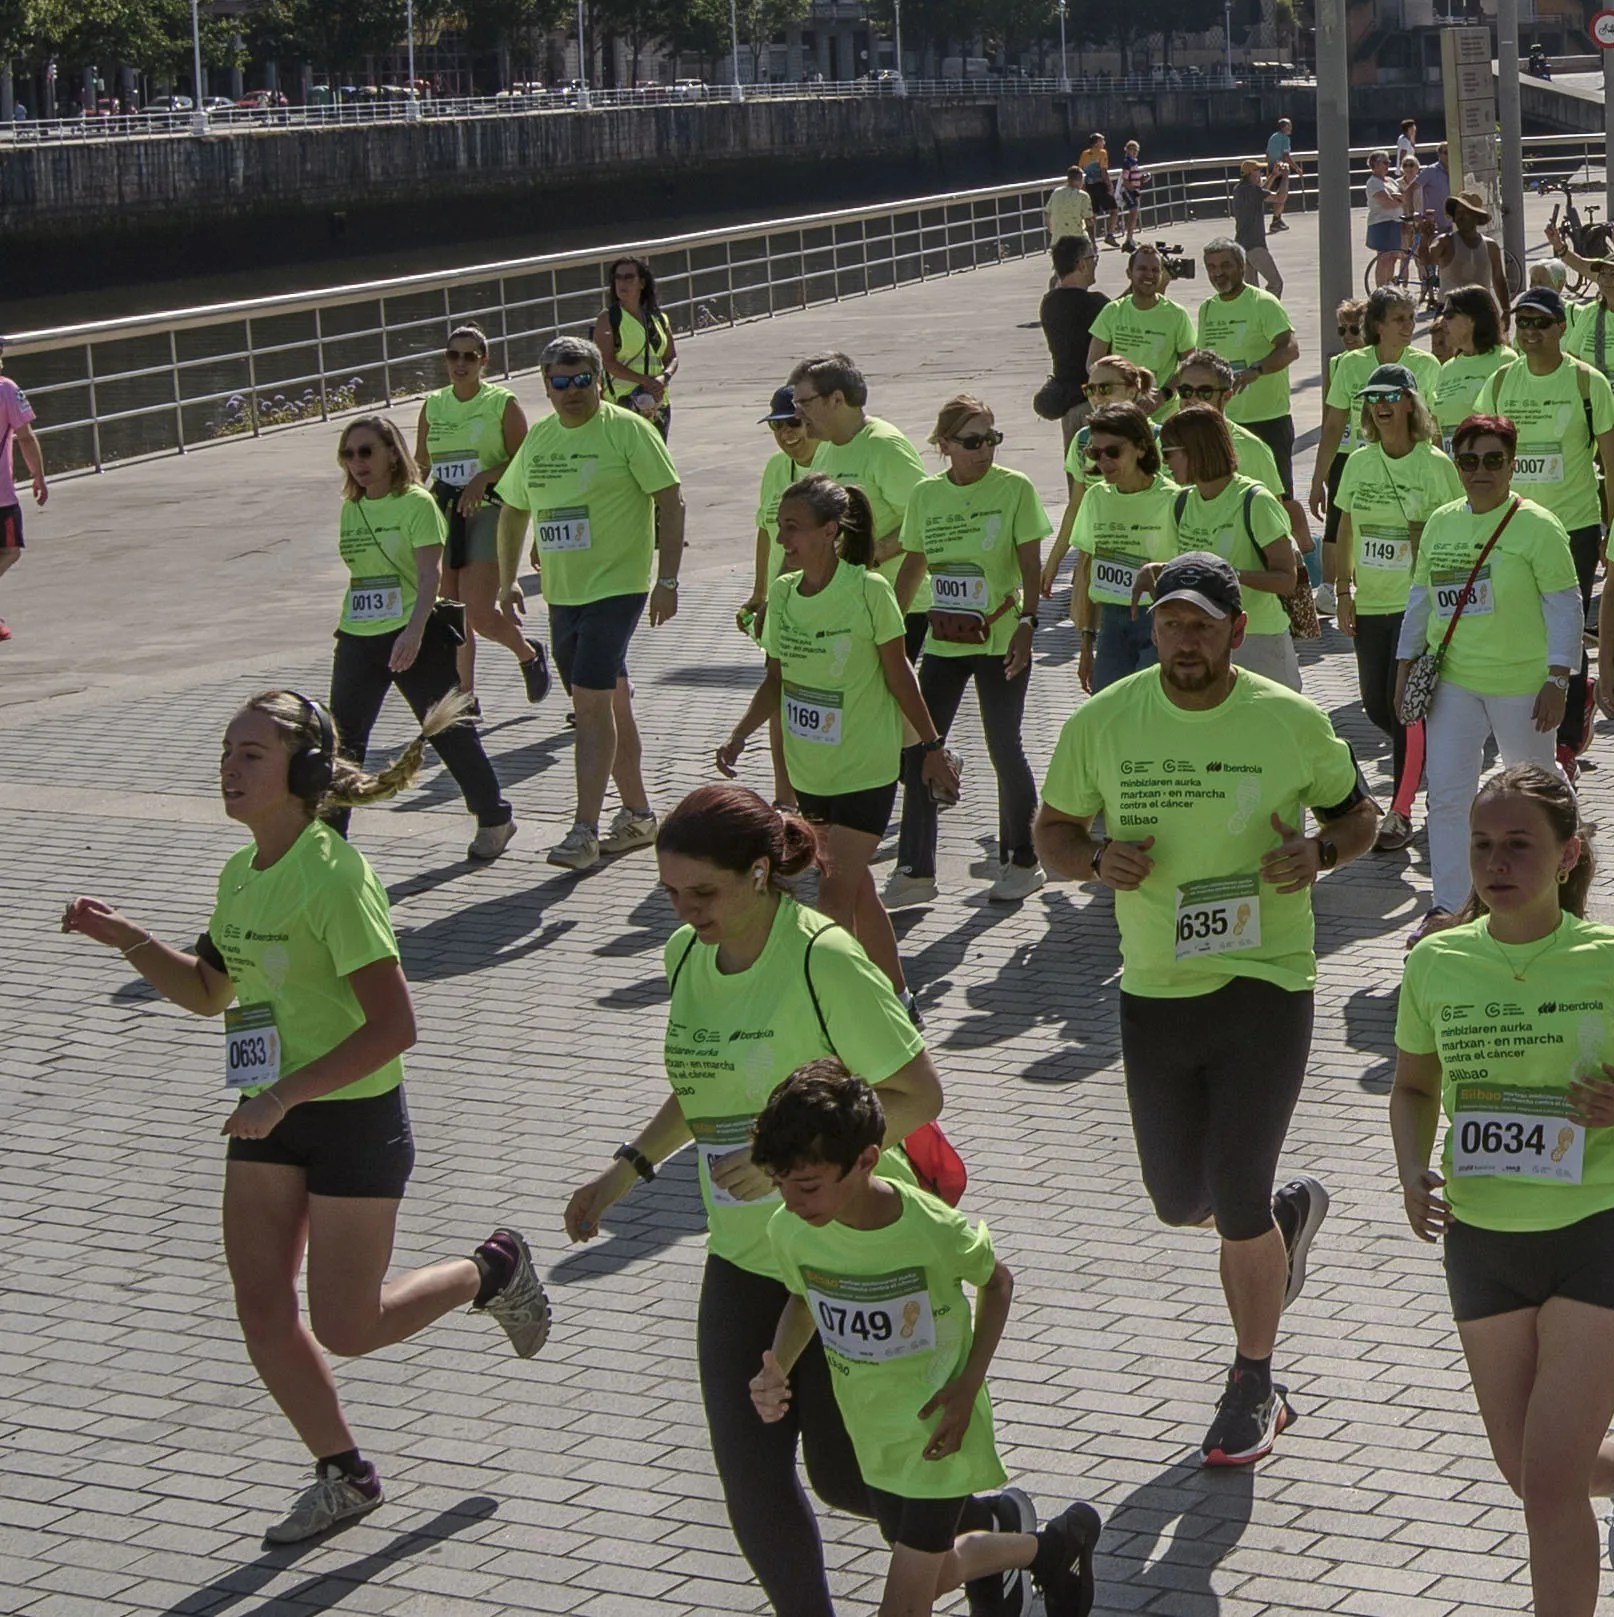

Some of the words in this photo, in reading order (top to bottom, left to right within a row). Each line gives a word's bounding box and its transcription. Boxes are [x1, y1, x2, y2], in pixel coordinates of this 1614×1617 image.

[436, 464, 465, 479] 1171
[540, 524, 570, 542] 0011
[1364, 541, 1395, 560] 1149
[1097, 564, 1133, 588] 0003
[936, 579, 967, 597] 0001
[352, 593, 384, 610] 0013
[787, 702, 819, 730] 1169
[1223, 763, 1263, 774] Iberdrola
[1120, 778, 1173, 788] minbiziaren
[1174, 778, 1202, 786] aurka
[1121, 789, 1161, 799] martxan
[1185, 789, 1226, 799] marcha
[1120, 801, 1147, 810] contra
[1149, 800, 1159, 808] el
[1160, 800, 1194, 808] cáncer
[1120, 815, 1158, 826] Bilbao
[1558, 1000, 1604, 1012] Iberdrola
[1441, 1025, 1497, 1037] minbiziaren
[1500, 1022, 1532, 1033] aurka
[1442, 1039, 1485, 1051] martxan
[1494, 1037, 1511, 1046] en
[1513, 1033, 1564, 1045] marcha
[230, 1036, 267, 1070] 0633
[1474, 1051, 1485, 1059] el
[1487, 1049, 1525, 1058] cáncer
[703, 1060, 735, 1071] marcha
[1449, 1068, 1489, 1082] Bilbao
[1460, 1088, 1501, 1100] Bilbao
[1461, 1121, 1546, 1156] 0634
[819, 1300, 893, 1341] 0749
